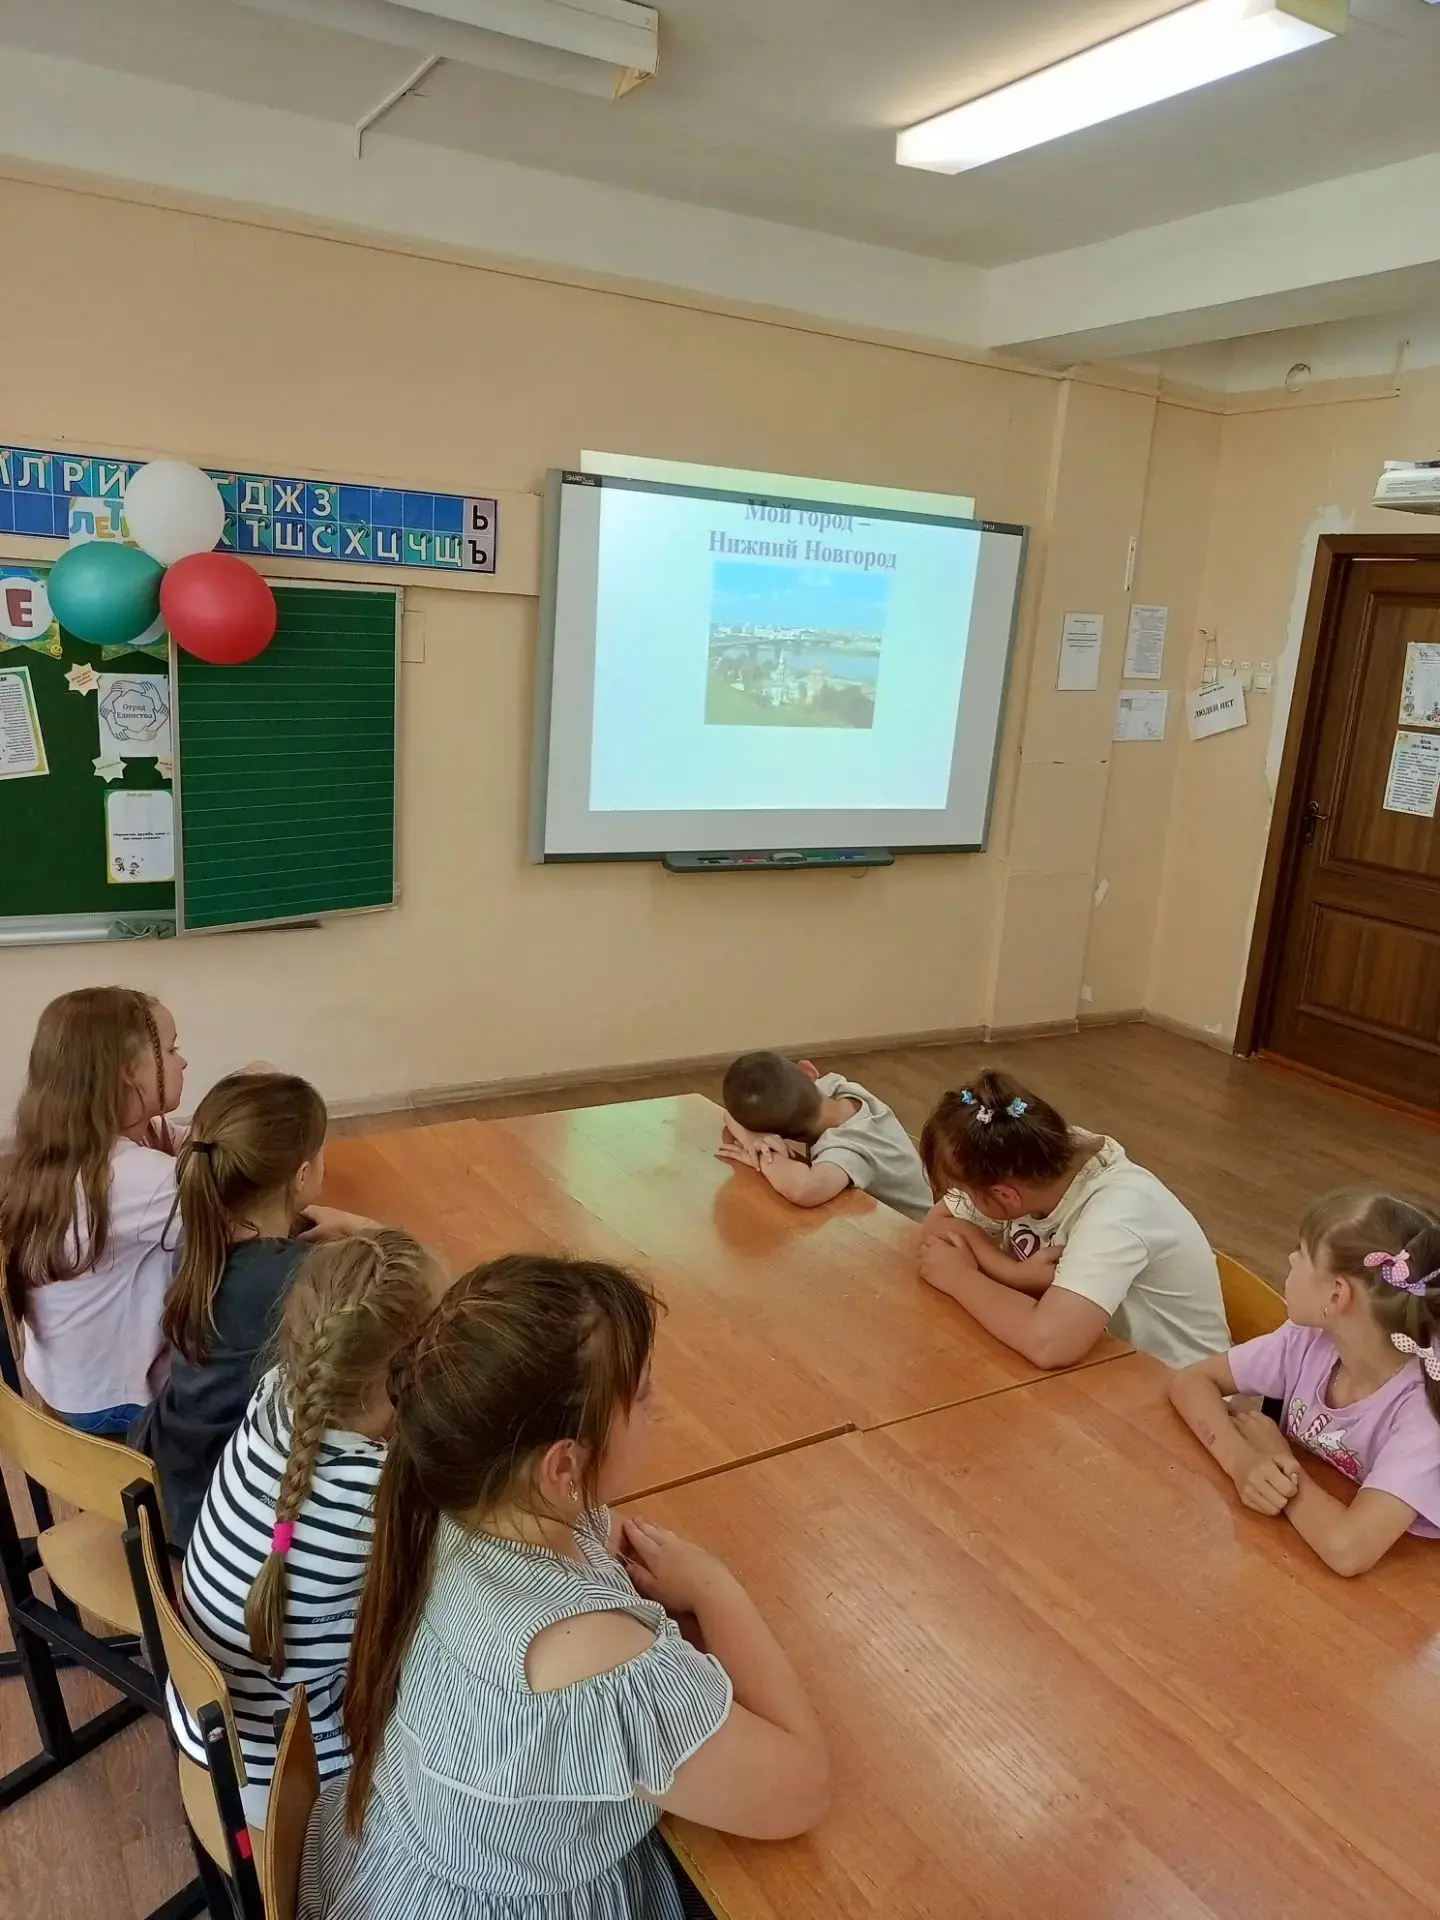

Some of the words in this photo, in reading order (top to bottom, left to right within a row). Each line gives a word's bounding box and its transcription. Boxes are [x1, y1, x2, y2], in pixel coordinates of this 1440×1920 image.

[70, 500, 130, 538] ЛЕТ
[745, 499, 792, 524] Мой
[798, 510, 854, 534] город
[709, 530, 799, 560] Нижний
[803, 540, 898, 571] Новгород
[116, 711, 153, 719] Единство
[1219, 699, 1235, 710] НЕТ
